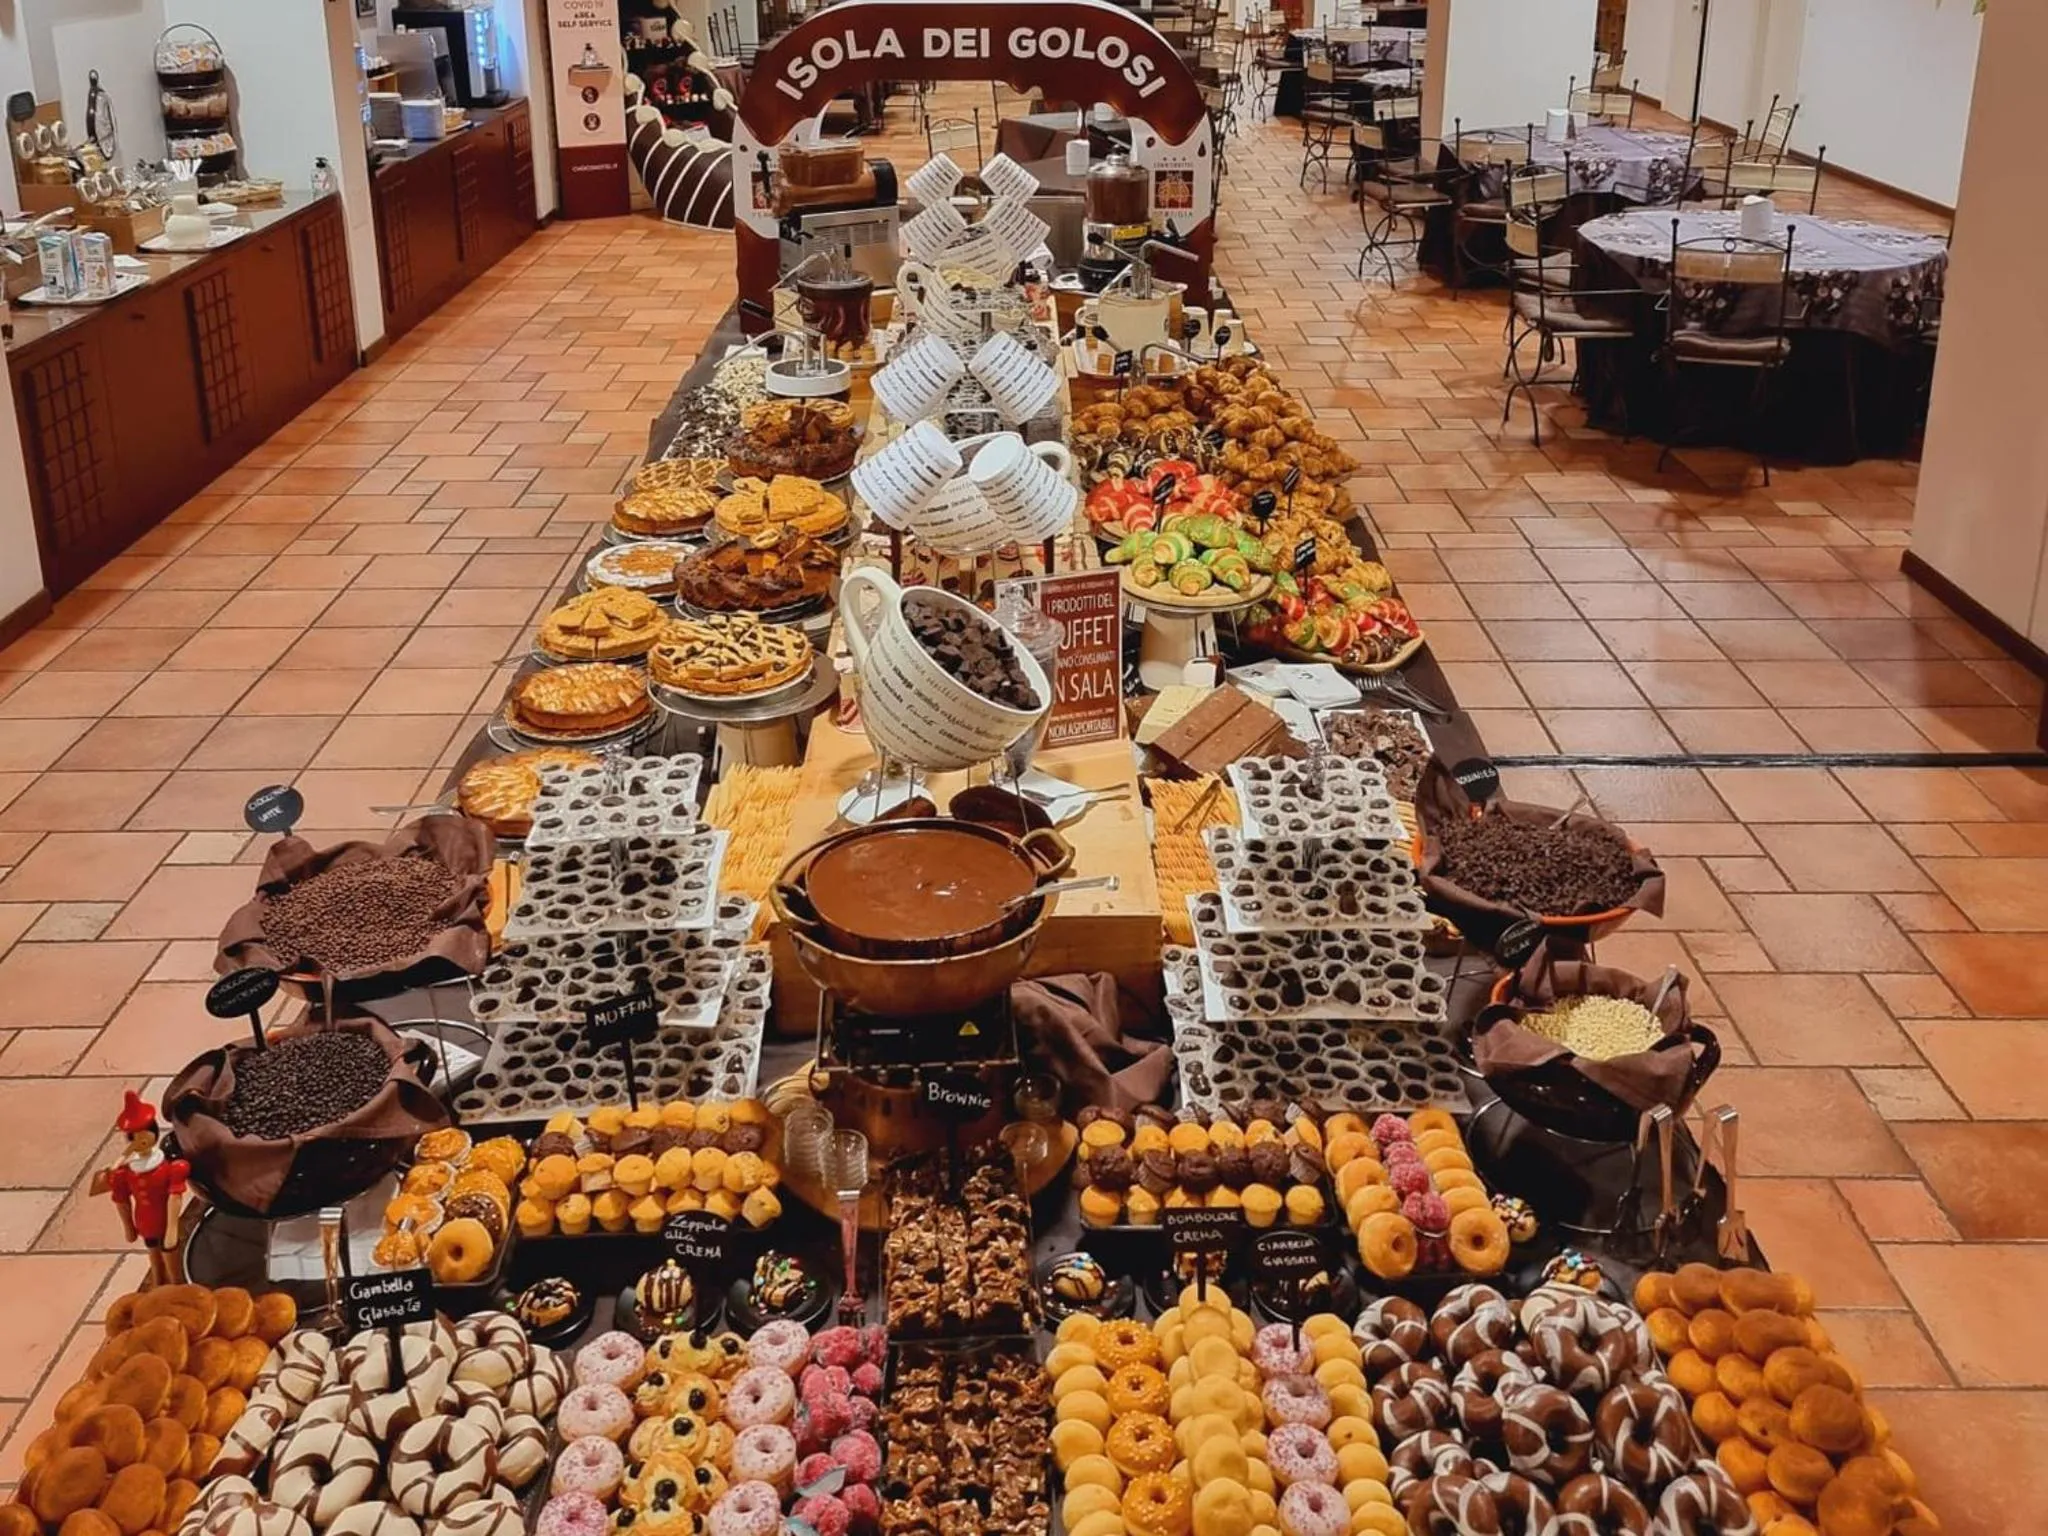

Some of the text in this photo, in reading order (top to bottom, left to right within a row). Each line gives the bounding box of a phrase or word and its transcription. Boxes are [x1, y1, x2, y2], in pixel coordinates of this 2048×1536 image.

[563, 1, 593, 9] COVID
[557, 19, 612, 28] SELF SERVICE
[775, 26, 1168, 101] ISOLA DEI GOLOSI
[1051, 594, 1096, 614] PRODOTTI
[1097, 592, 1116, 608] DEL
[1059, 614, 1115, 650] UFFET
[1055, 675, 1066, 703] N
[1070, 668, 1115, 702] SALA
[1049, 717, 1116, 738] NON ASPORTABILI
[594, 995, 653, 1027] MUFFIN
[668, 1214, 728, 1233] Zeppole
[1173, 1229, 1224, 1243] CREMA
[675, 1243, 722, 1258] CREMA
